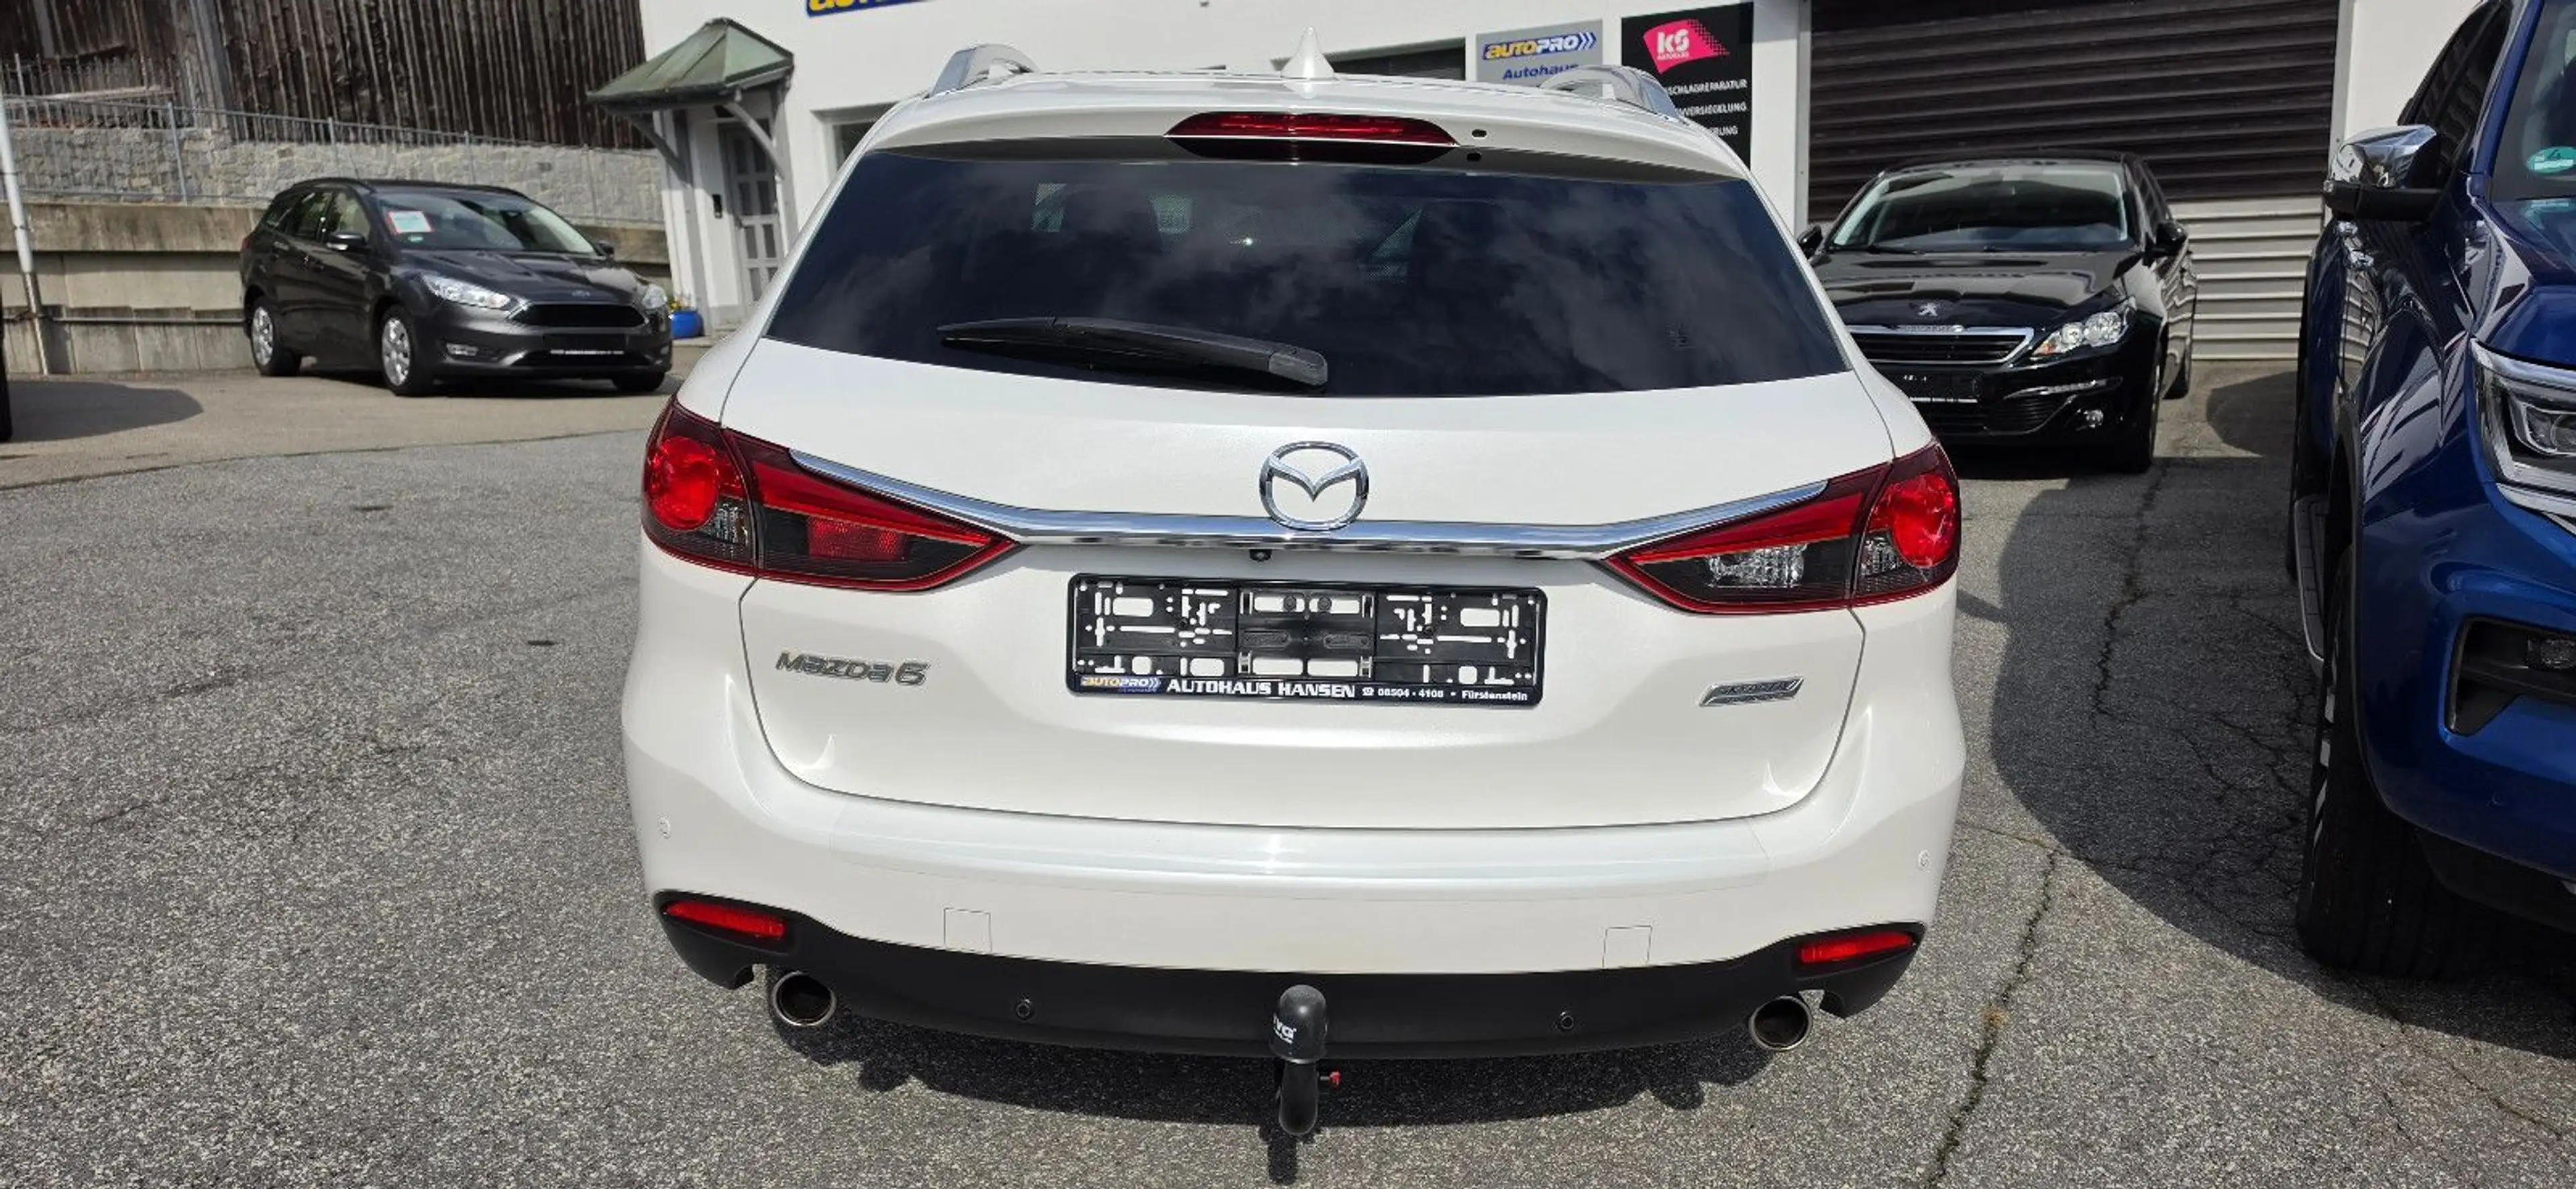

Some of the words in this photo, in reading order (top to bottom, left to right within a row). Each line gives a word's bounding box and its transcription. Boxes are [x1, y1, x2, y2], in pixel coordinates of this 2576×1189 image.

[1664, 78, 1747, 95] SCHLAGREPARATUR
[1678, 101, 1747, 117] VERSIEGELUNG
[1167, 679, 1271, 695] AUTOHAUS
[1278, 682, 1356, 698] HANSEN
[1461, 689, 1528, 701] Fürstenstein
